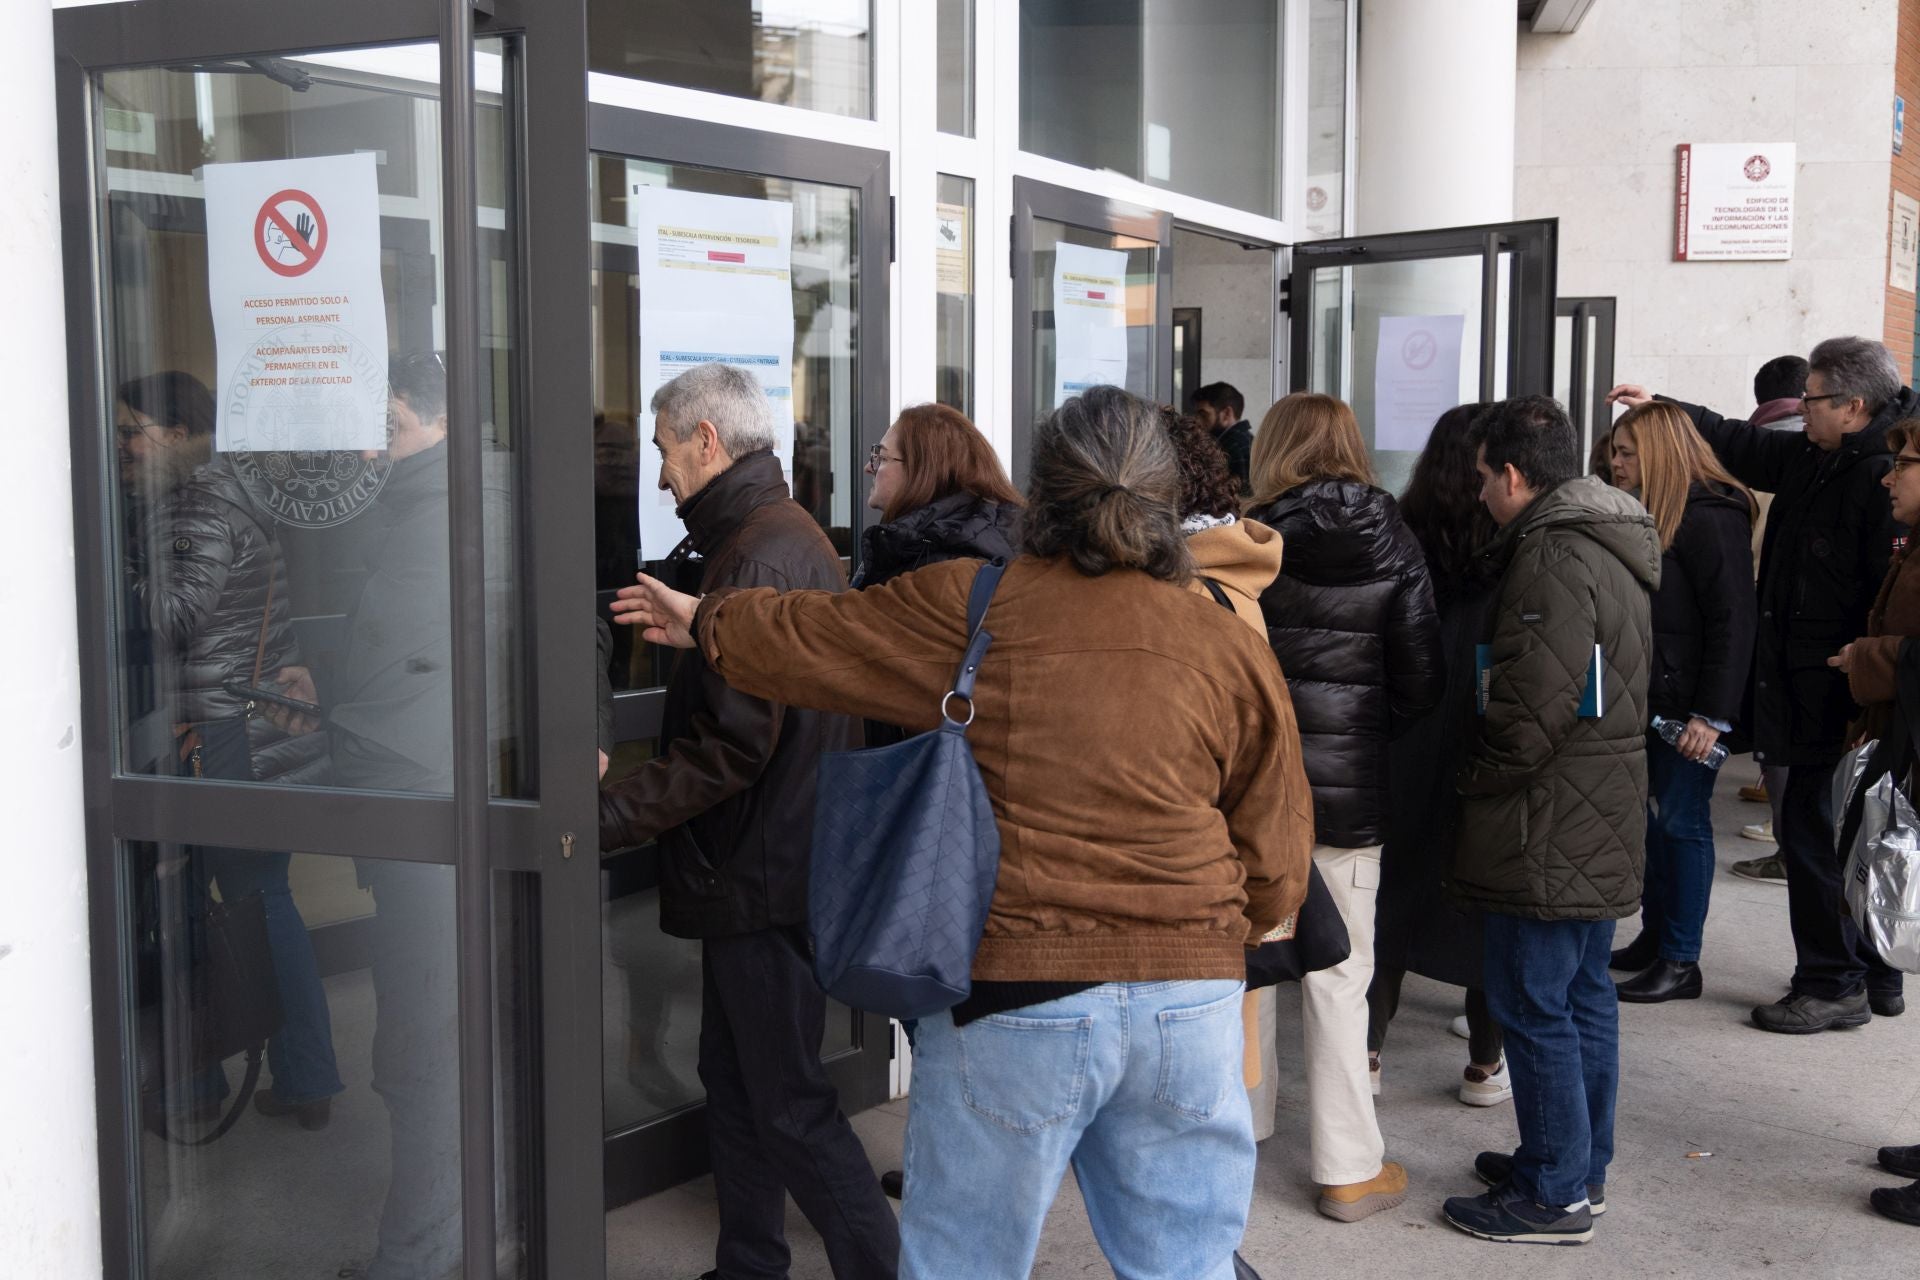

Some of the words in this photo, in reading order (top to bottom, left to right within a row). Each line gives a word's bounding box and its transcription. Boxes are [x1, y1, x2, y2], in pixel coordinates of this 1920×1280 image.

[1680, 195, 1687, 204] DE
[672, 230, 697, 239] SUBESCALA
[244, 297, 273, 308] ACCESO
[275, 296, 318, 307] PERMITIDO
[320, 295, 338, 306] SOLO
[340, 295, 349, 305] A
[256, 314, 297, 325] PERSONAL
[298, 313, 340, 324] ASPIRANTE
[256, 344, 320, 357] ACOMPAÑANTES
[322, 344, 348, 355] DEBEN
[265, 361, 316, 371] PERMANECER
[318, 361, 328, 370] EN
[330, 360, 339, 370] EL
[250, 376, 287, 386] EXTERIOR
[289, 376, 299, 386] DE
[300, 375, 310, 385] LA
[312, 374, 352, 386] FACULTAD
